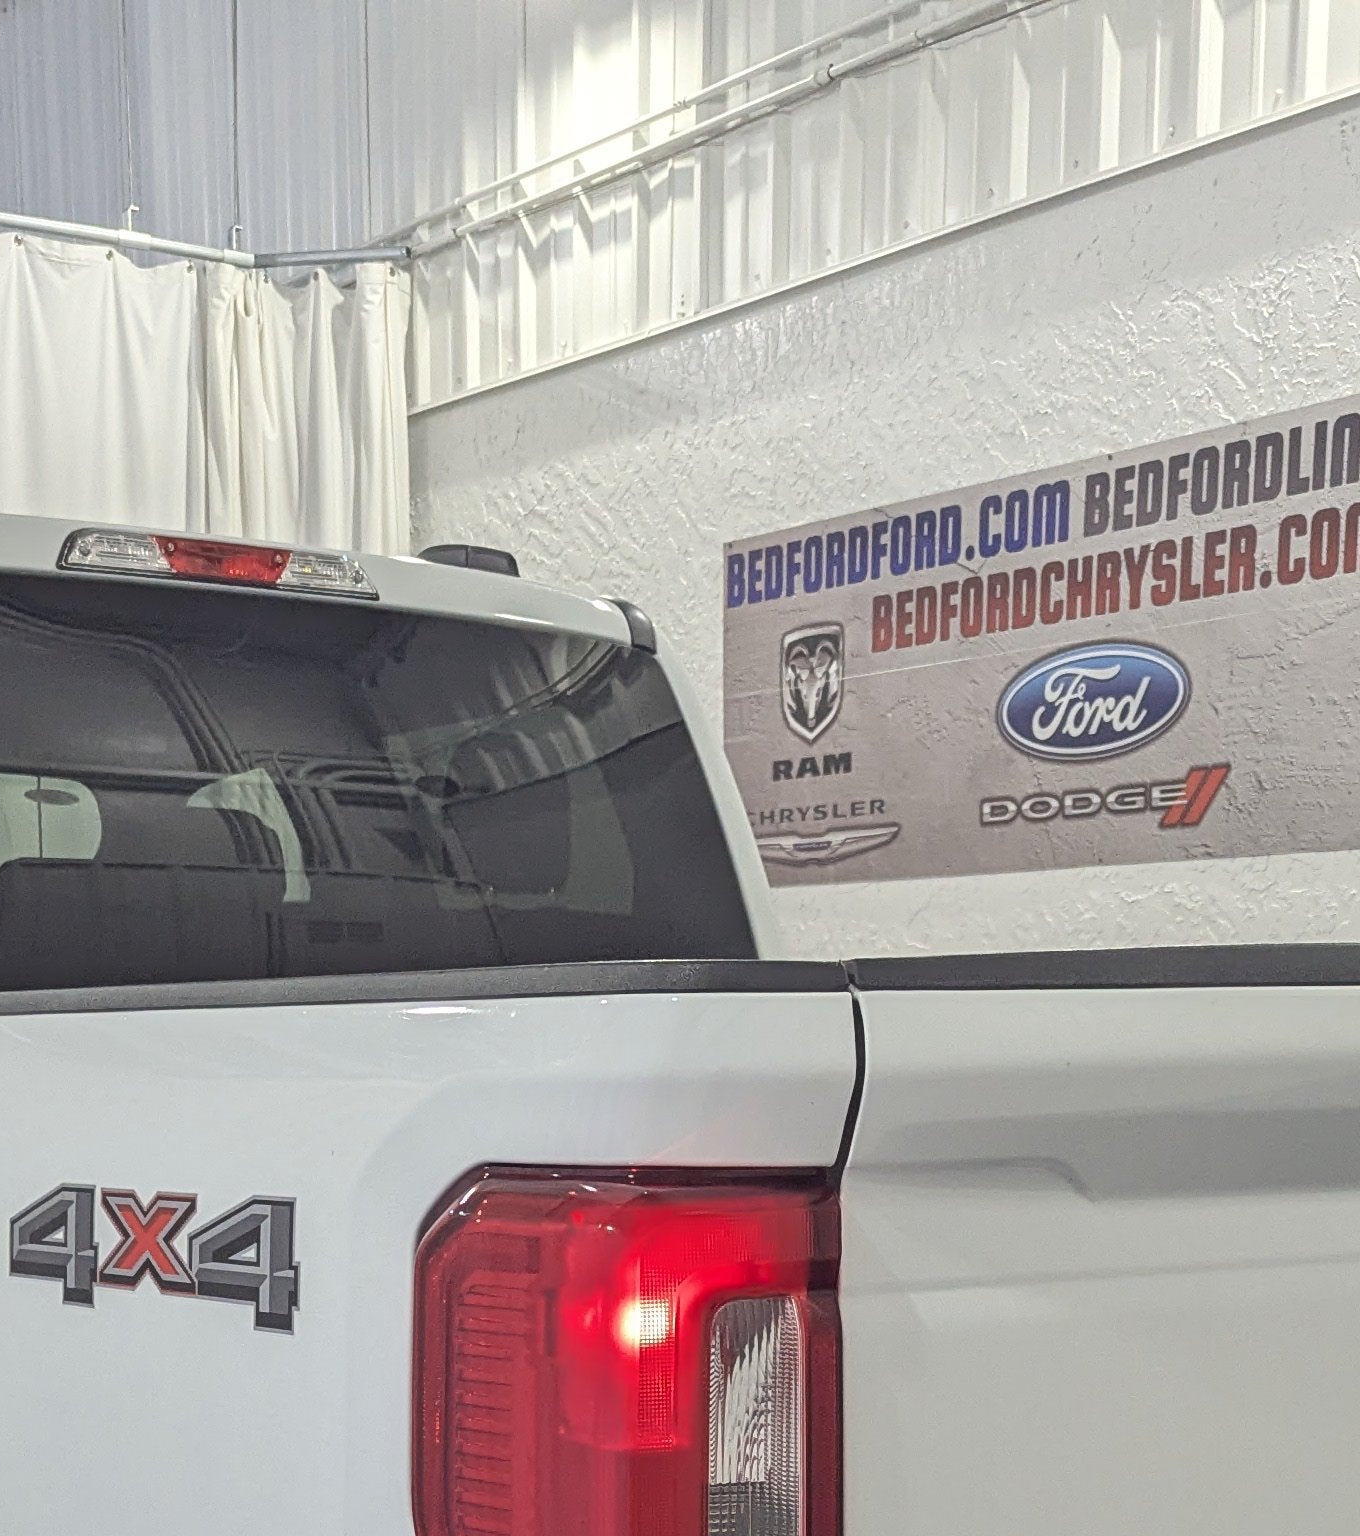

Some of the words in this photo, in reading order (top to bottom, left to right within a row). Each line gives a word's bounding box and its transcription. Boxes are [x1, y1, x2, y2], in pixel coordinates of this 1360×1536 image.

[727, 479, 1070, 608] BEDFORDFORD.COM
[1032, 664, 1151, 741] Ford
[772, 752, 852, 782] RAM
[980, 782, 1188, 827] DODGE
